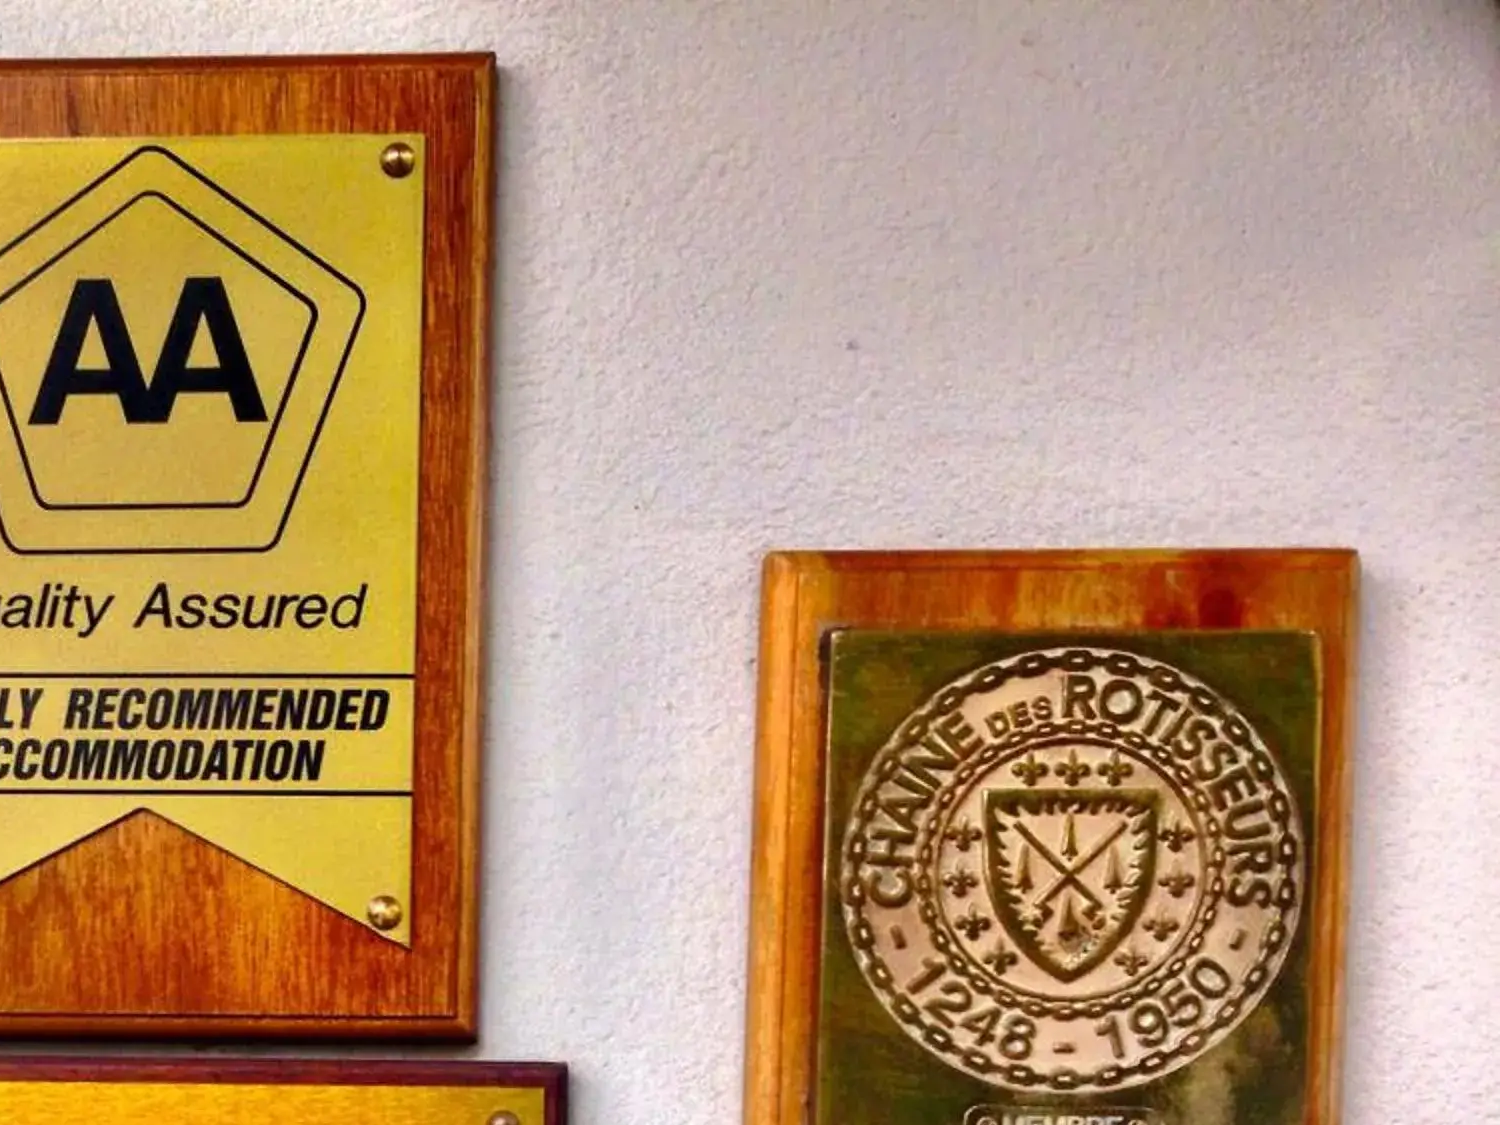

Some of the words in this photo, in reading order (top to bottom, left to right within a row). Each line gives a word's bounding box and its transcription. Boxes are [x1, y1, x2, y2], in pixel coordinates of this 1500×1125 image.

[27, 275, 269, 425] AA
[133, 583, 368, 629] Assured
[64, 688, 389, 732] RECOMMENDED
[866, 710, 983, 907] CHAINE
[984, 695, 1053, 739] DES
[1059, 672, 1277, 910] ROTISSEURS
[905, 956, 1038, 1061] 1248
[1095, 957, 1232, 1060] 1950
